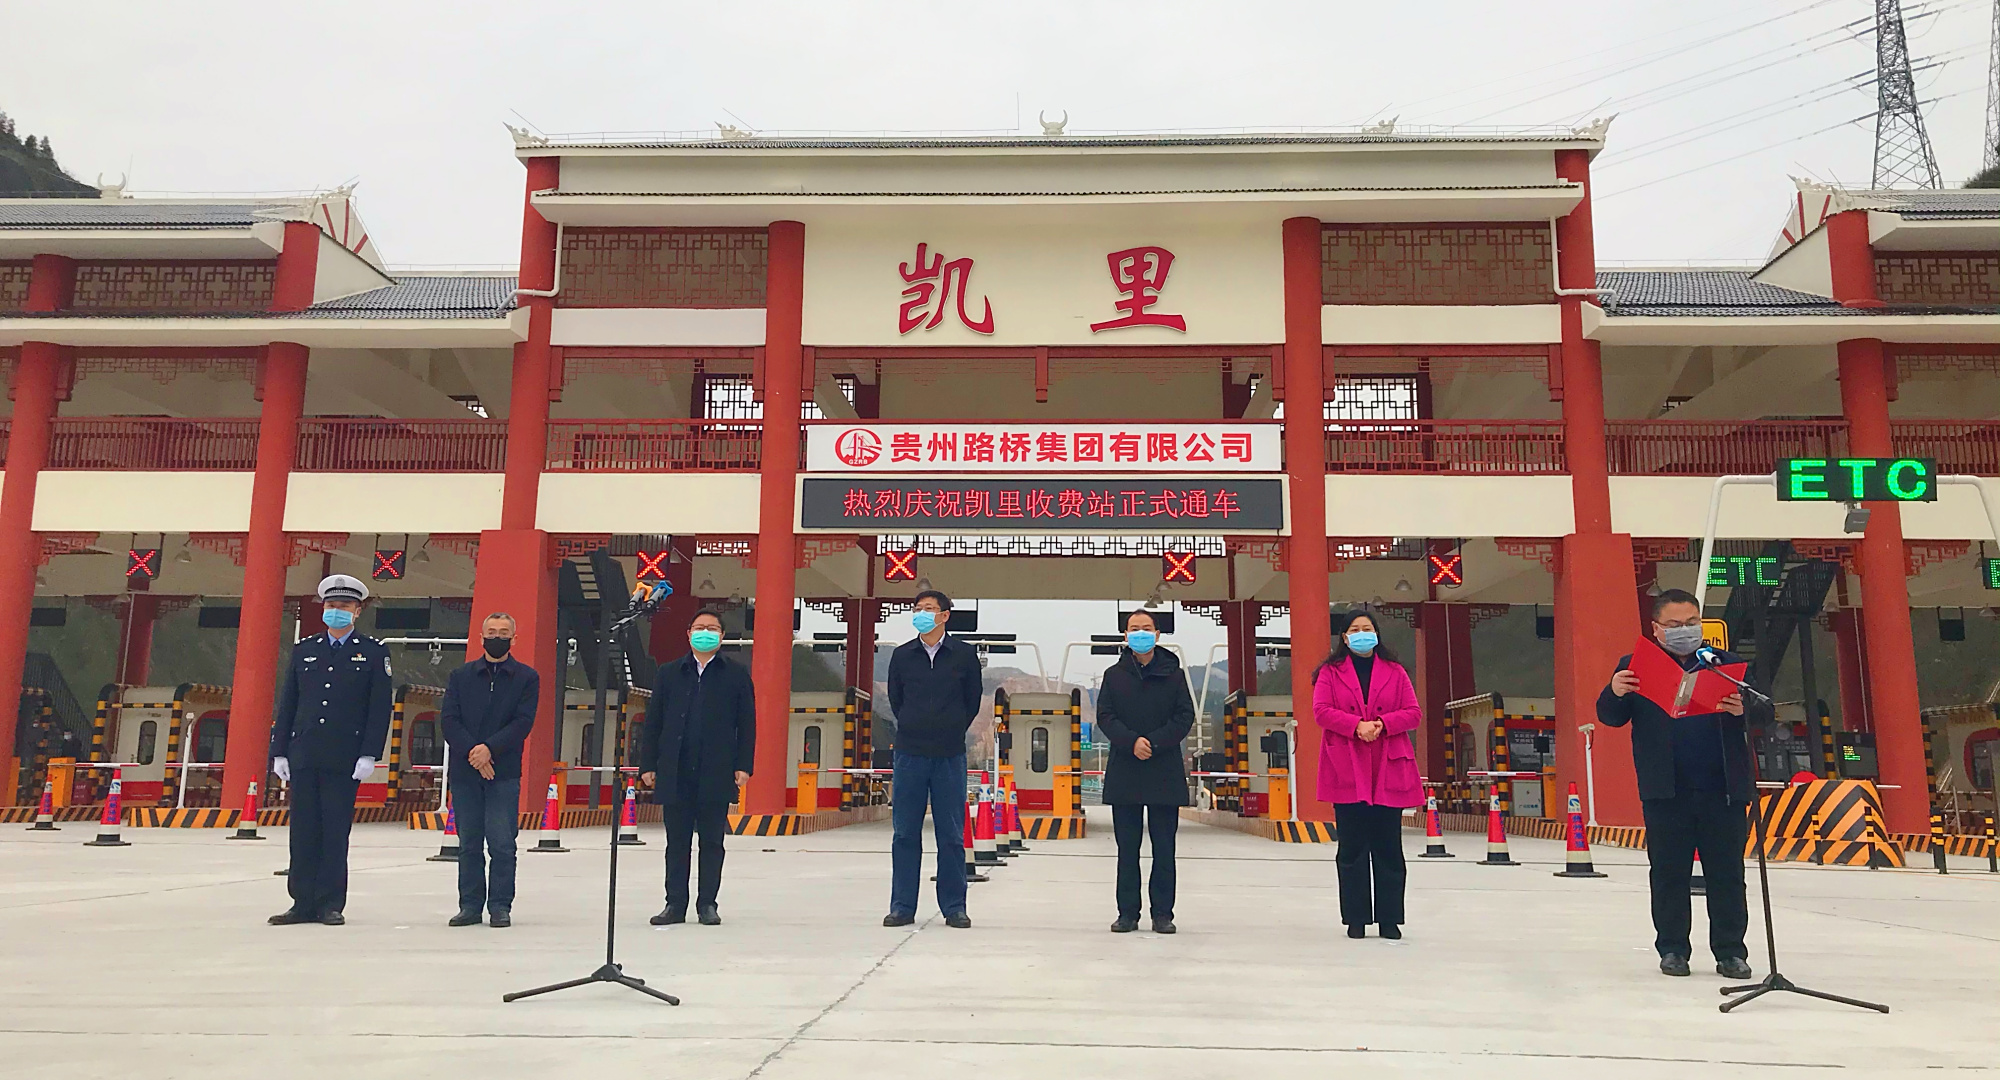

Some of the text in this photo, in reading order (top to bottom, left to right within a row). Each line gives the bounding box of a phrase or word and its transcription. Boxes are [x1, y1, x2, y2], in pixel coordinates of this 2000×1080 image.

[898, 243, 1187, 335] 凯里
[890, 432, 1253, 463] 贵州路桥集团有限公司
[1790, 459, 1927, 499] ETC
[843, 488, 1241, 519] 热烈庆祝凯里收费站正式通车
[1706, 556, 1779, 586] ETC
[1703, 637, 1722, 647] m/h
